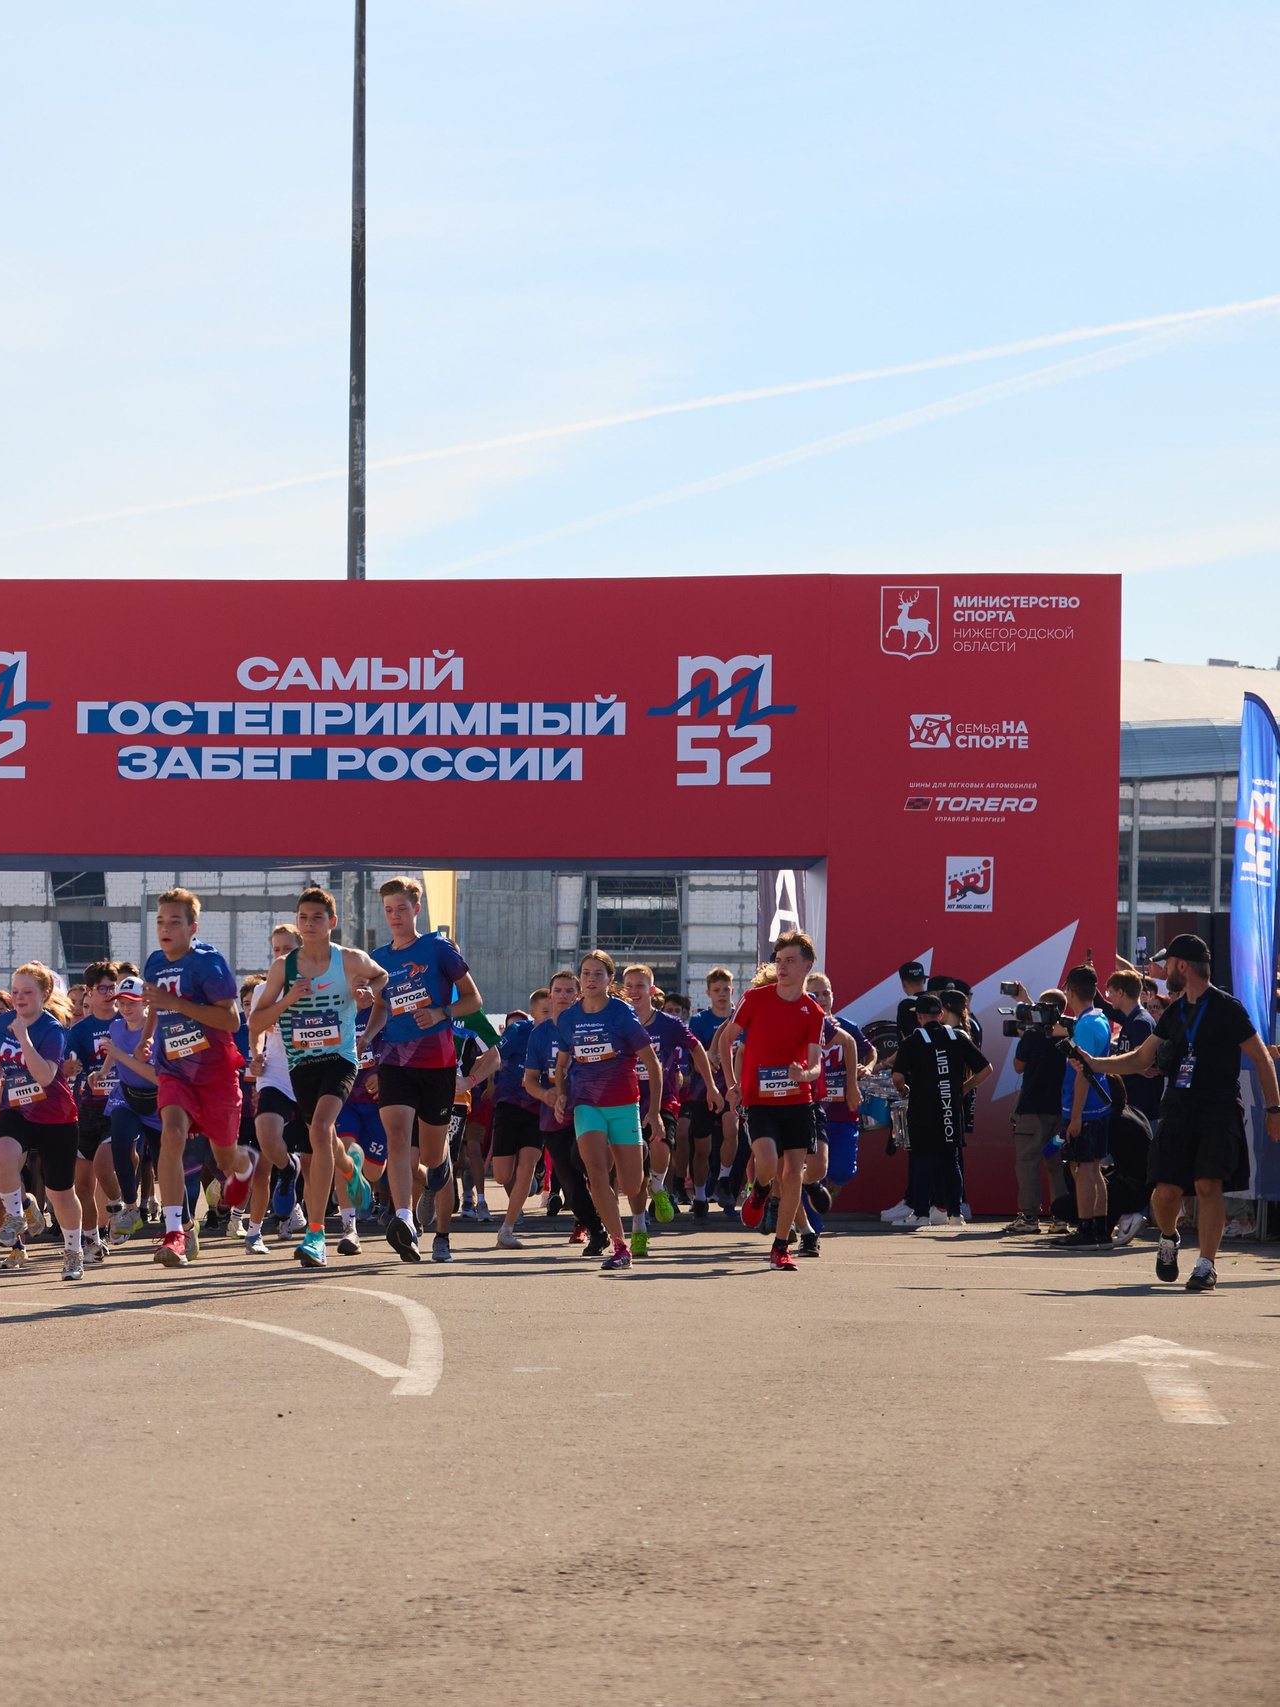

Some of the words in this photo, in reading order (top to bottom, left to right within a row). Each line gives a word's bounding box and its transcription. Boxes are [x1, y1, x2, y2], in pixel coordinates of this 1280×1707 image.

[953, 595, 1080, 609] МИНИСТЕРСТВО
[953, 610, 1016, 622] СПОРТА
[953, 626, 1074, 640] НИЖЕГОРОДСКОЙ
[953, 641, 1016, 652] ОБЛАСТИ
[236, 649, 464, 691] САМЫЙ
[76, 694, 627, 736] ГОСТЕПРИИМНЫЙ
[955, 723, 1000, 734] СЕМЬЯ
[1002, 720, 1029, 734] НА
[955, 735, 1029, 749] СПОРТЕ
[677, 724, 772, 785] 52
[117, 745, 312, 780] ЗАБЕГ
[327, 746, 583, 782] РОССИИ
[935, 797, 1038, 812] TORERO
[394, 992, 423, 1006] 10702
[299, 1029, 332, 1039] 11068
[169, 1035, 197, 1049] 10164
[580, 1046, 606, 1054] 10107
[935, 1049, 949, 1075] БИТ
[15, 1087, 32, 1096] 11111
[765, 1080, 795, 1089] 10794
[937, 1080, 954, 1142] ГОРЬКИЙ
[369, 1141, 384, 1155] 52
